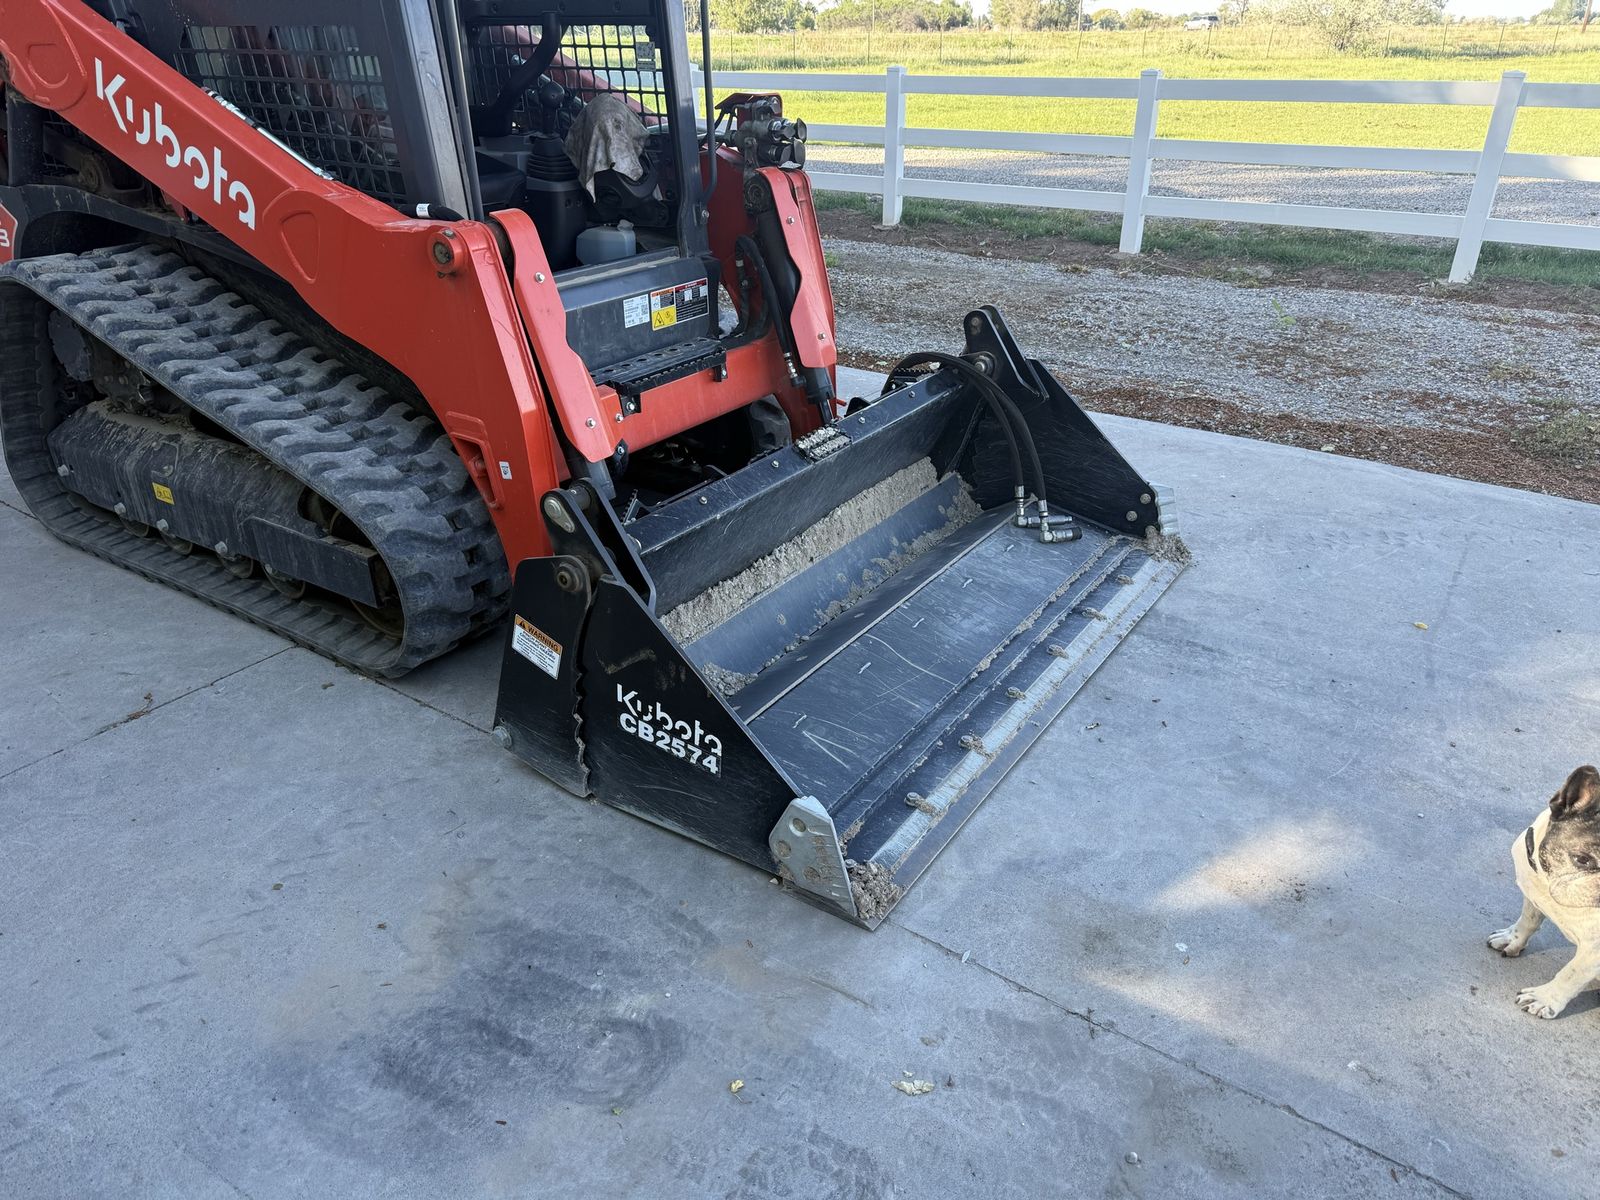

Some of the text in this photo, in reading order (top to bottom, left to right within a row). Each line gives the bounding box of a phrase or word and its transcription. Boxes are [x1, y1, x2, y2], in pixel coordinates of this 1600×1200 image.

[95, 57, 256, 230] Kubota
[527, 626, 558, 652] WARNING
[616, 683, 722, 756] Kubota
[619, 713, 719, 775] CB2574
